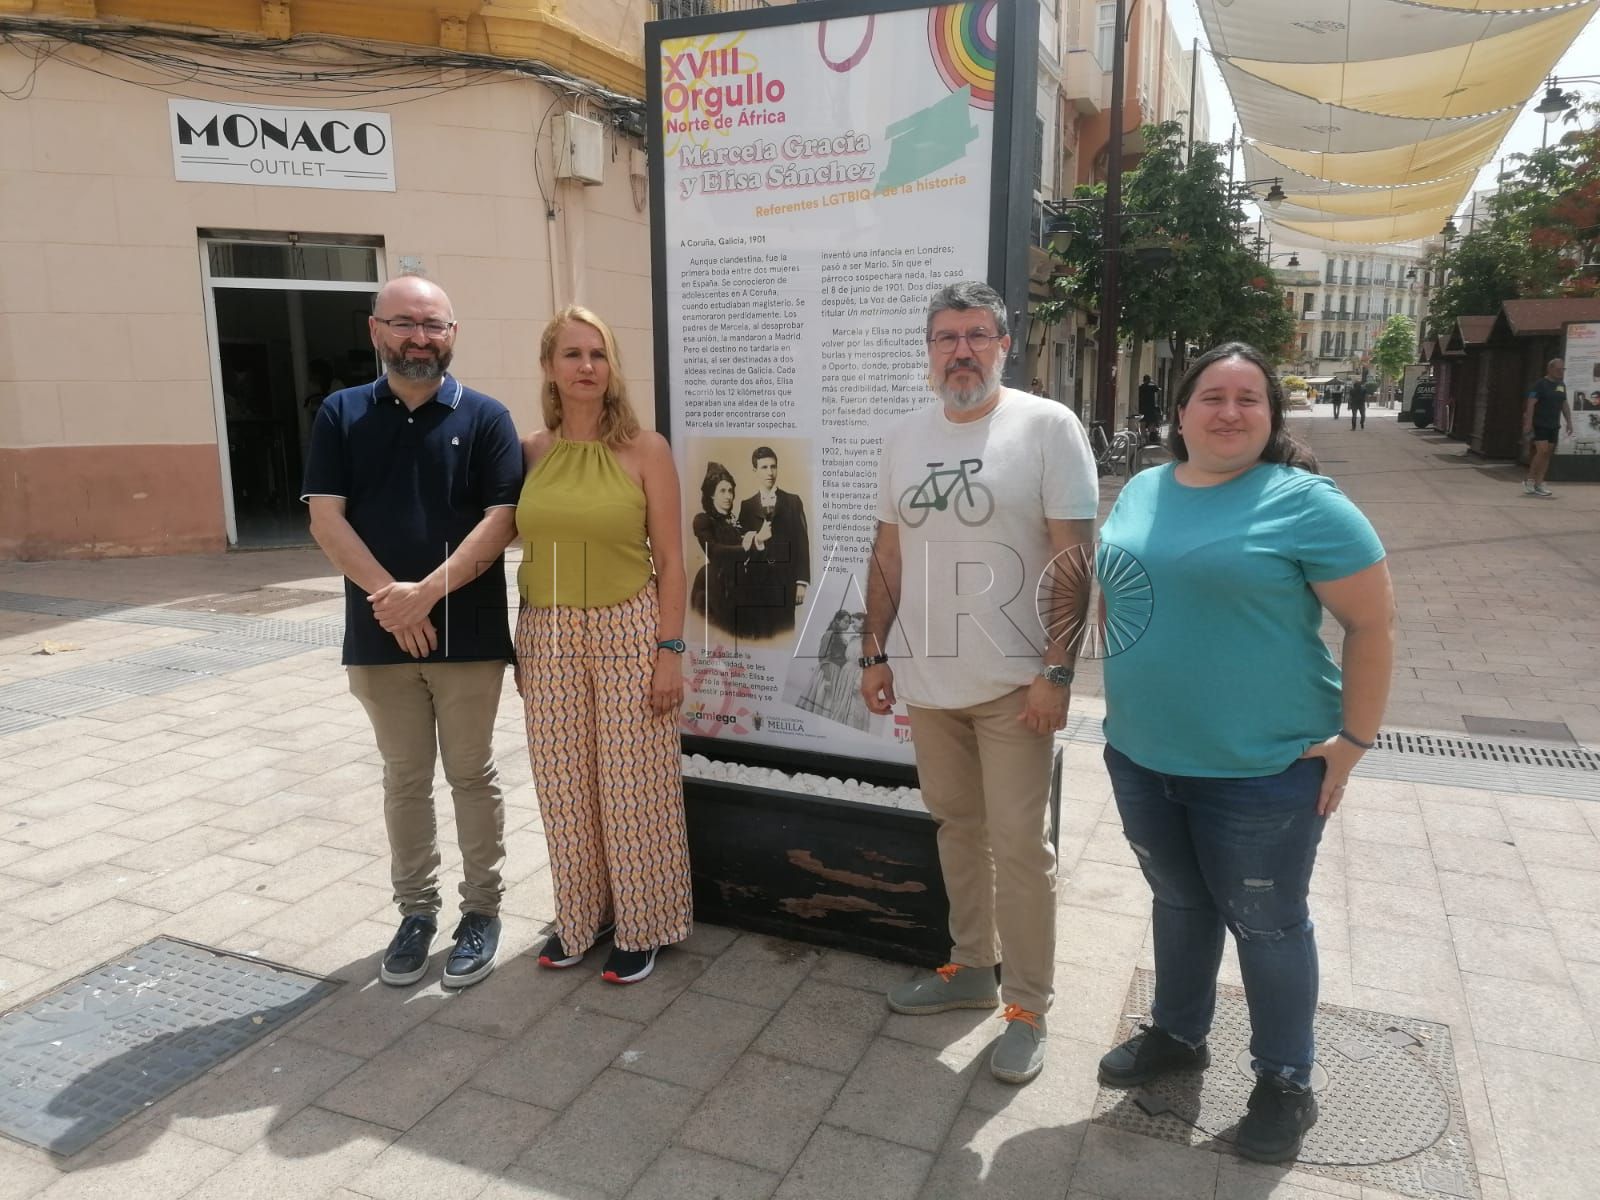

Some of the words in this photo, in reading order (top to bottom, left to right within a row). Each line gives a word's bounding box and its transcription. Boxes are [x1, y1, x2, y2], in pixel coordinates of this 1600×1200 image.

[663, 47, 739, 82] XVIII
[663, 72, 785, 117] Orgullo
[177, 112, 386, 156] MONACO
[666, 118, 710, 134] Norte
[714, 114, 733, 129] de
[738, 108, 786, 127] África
[250, 158, 325, 177] OUTLET
[681, 138, 778, 169] Marcela
[680, 178, 698, 200] y
[700, 169, 762, 195] Elisa
[766, 160, 876, 190] Sánchez
[756, 199, 819, 217] Referentes
[902, 184, 913, 194] la
[916, 173, 967, 191] historia
[892, 361, 928, 370] probable
[860, 437, 882, 446] puest
[695, 711, 737, 724] amiega
[767, 721, 805, 732] MELILLA
